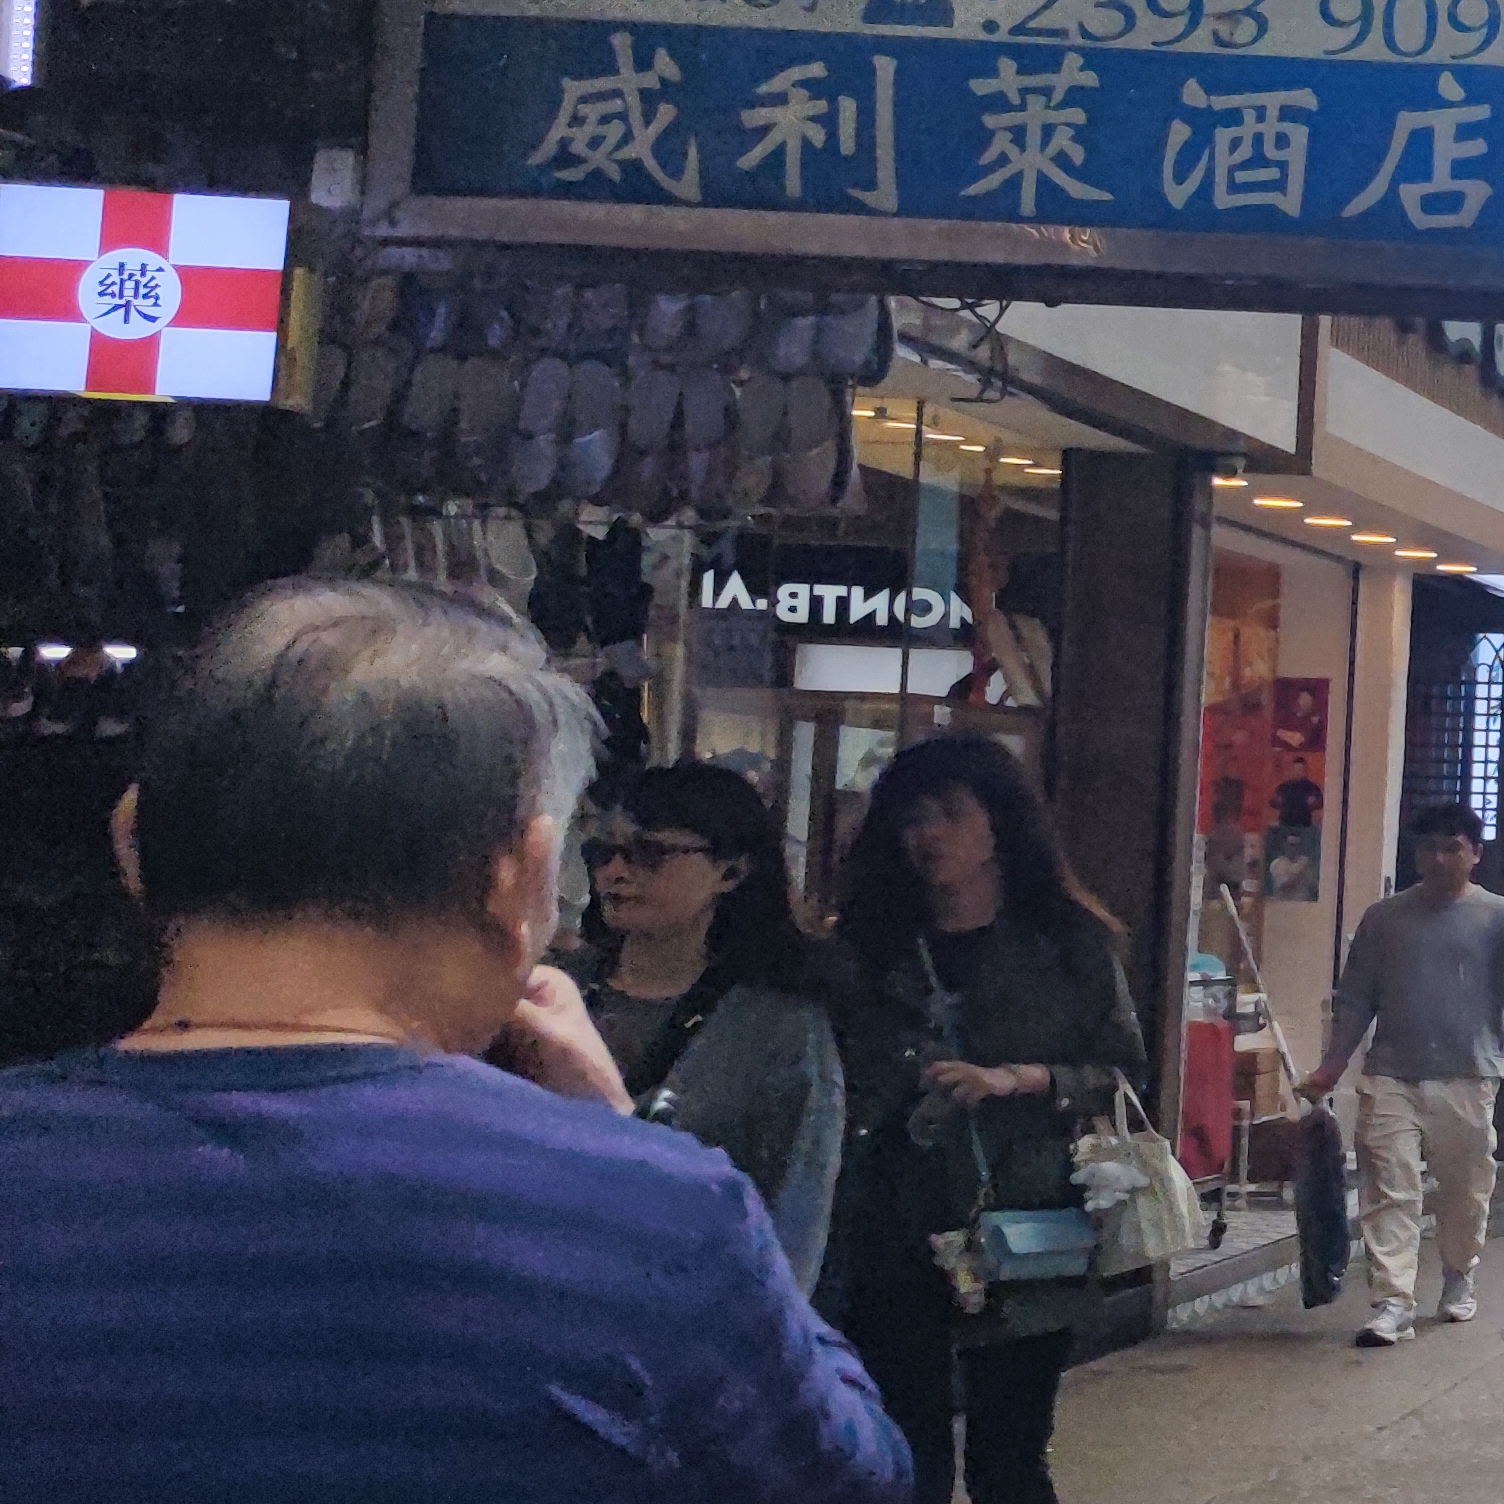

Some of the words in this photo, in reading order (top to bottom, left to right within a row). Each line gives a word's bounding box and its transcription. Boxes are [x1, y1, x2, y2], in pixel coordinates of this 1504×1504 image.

[526, 29, 1501, 234] 威利萊酒店
[93, 261, 166, 325] 藥
